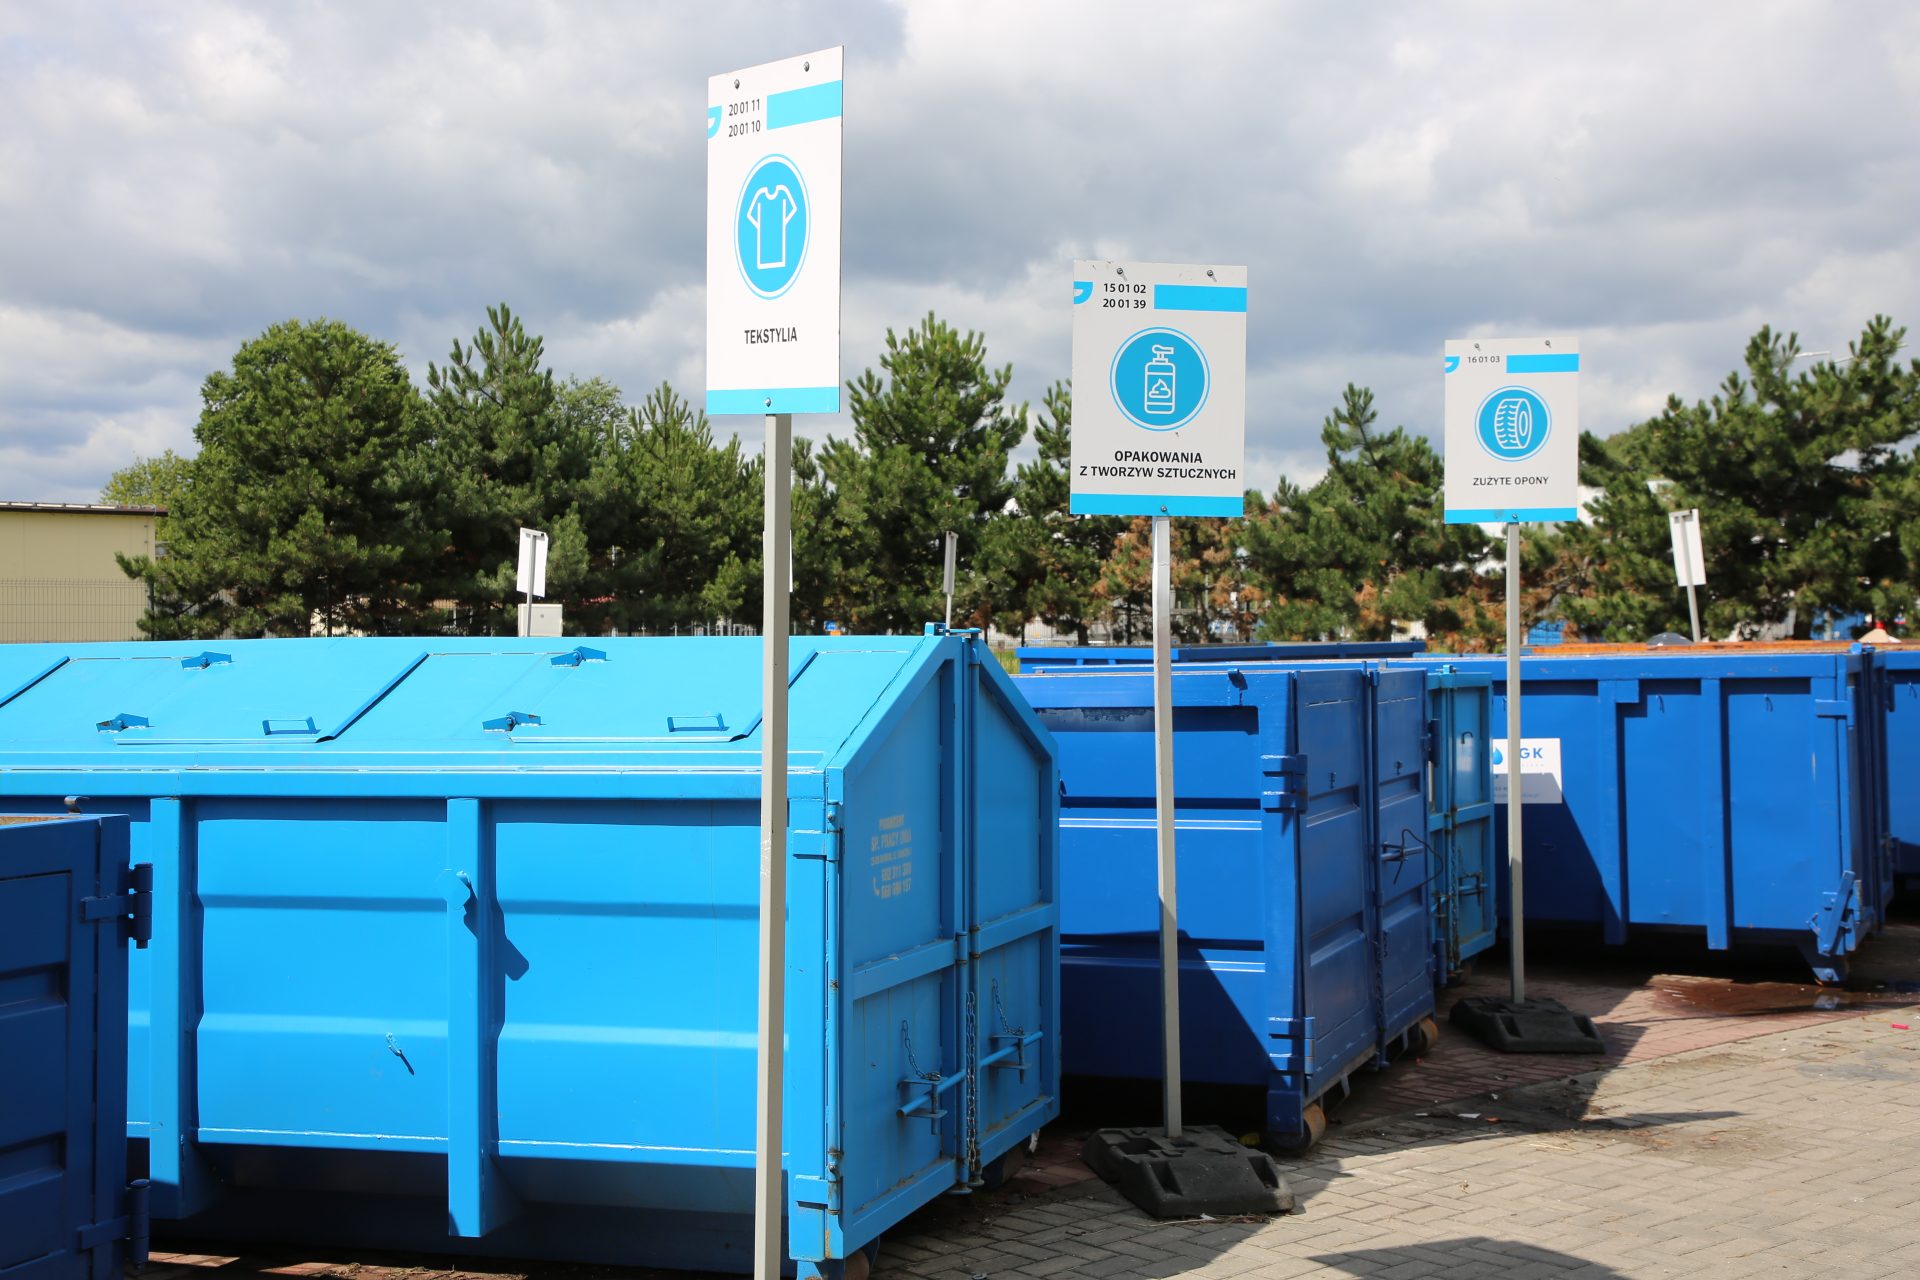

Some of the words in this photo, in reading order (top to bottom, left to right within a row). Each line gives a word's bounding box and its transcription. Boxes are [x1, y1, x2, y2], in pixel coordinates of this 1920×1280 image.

[744, 326, 798, 345] TEKSTYLIA
[1114, 450, 1203, 464] OPAKOWANIA
[1079, 465, 1088, 476] Z
[1090, 466, 1154, 478] TWORZYW
[1156, 467, 1236, 480] SZTUCZNYCH
[1472, 475, 1512, 486] ZUŻYTE
[1514, 476, 1549, 485] OPONY
[1519, 746, 1544, 760] GK
